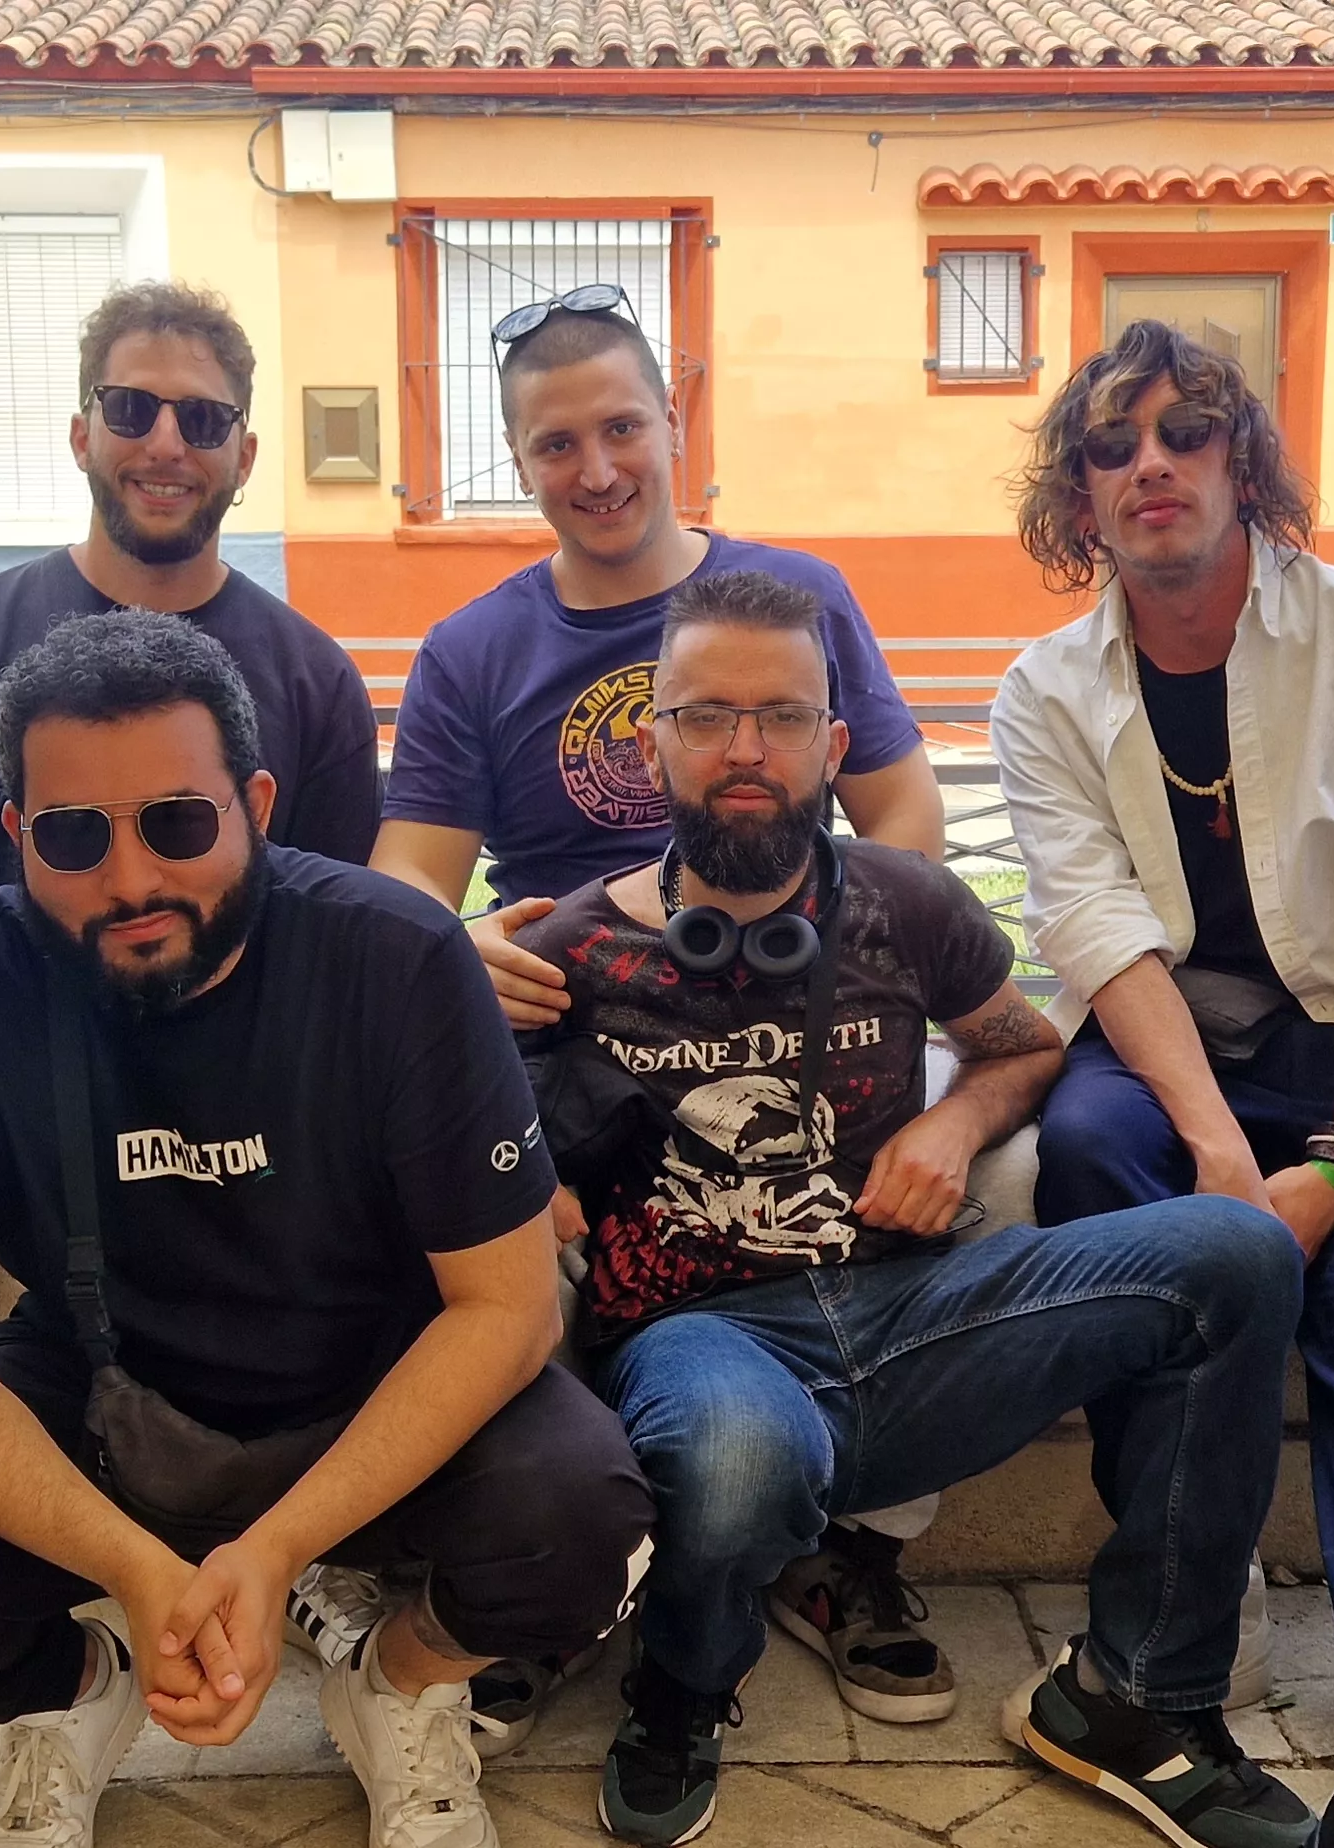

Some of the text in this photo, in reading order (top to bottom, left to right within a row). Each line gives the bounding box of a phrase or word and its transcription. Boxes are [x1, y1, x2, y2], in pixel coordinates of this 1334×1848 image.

[566, 671, 654, 755] QUIKS
[597, 1033, 742, 1074] NSANE
[126, 1133, 268, 1175] HAMILTON
